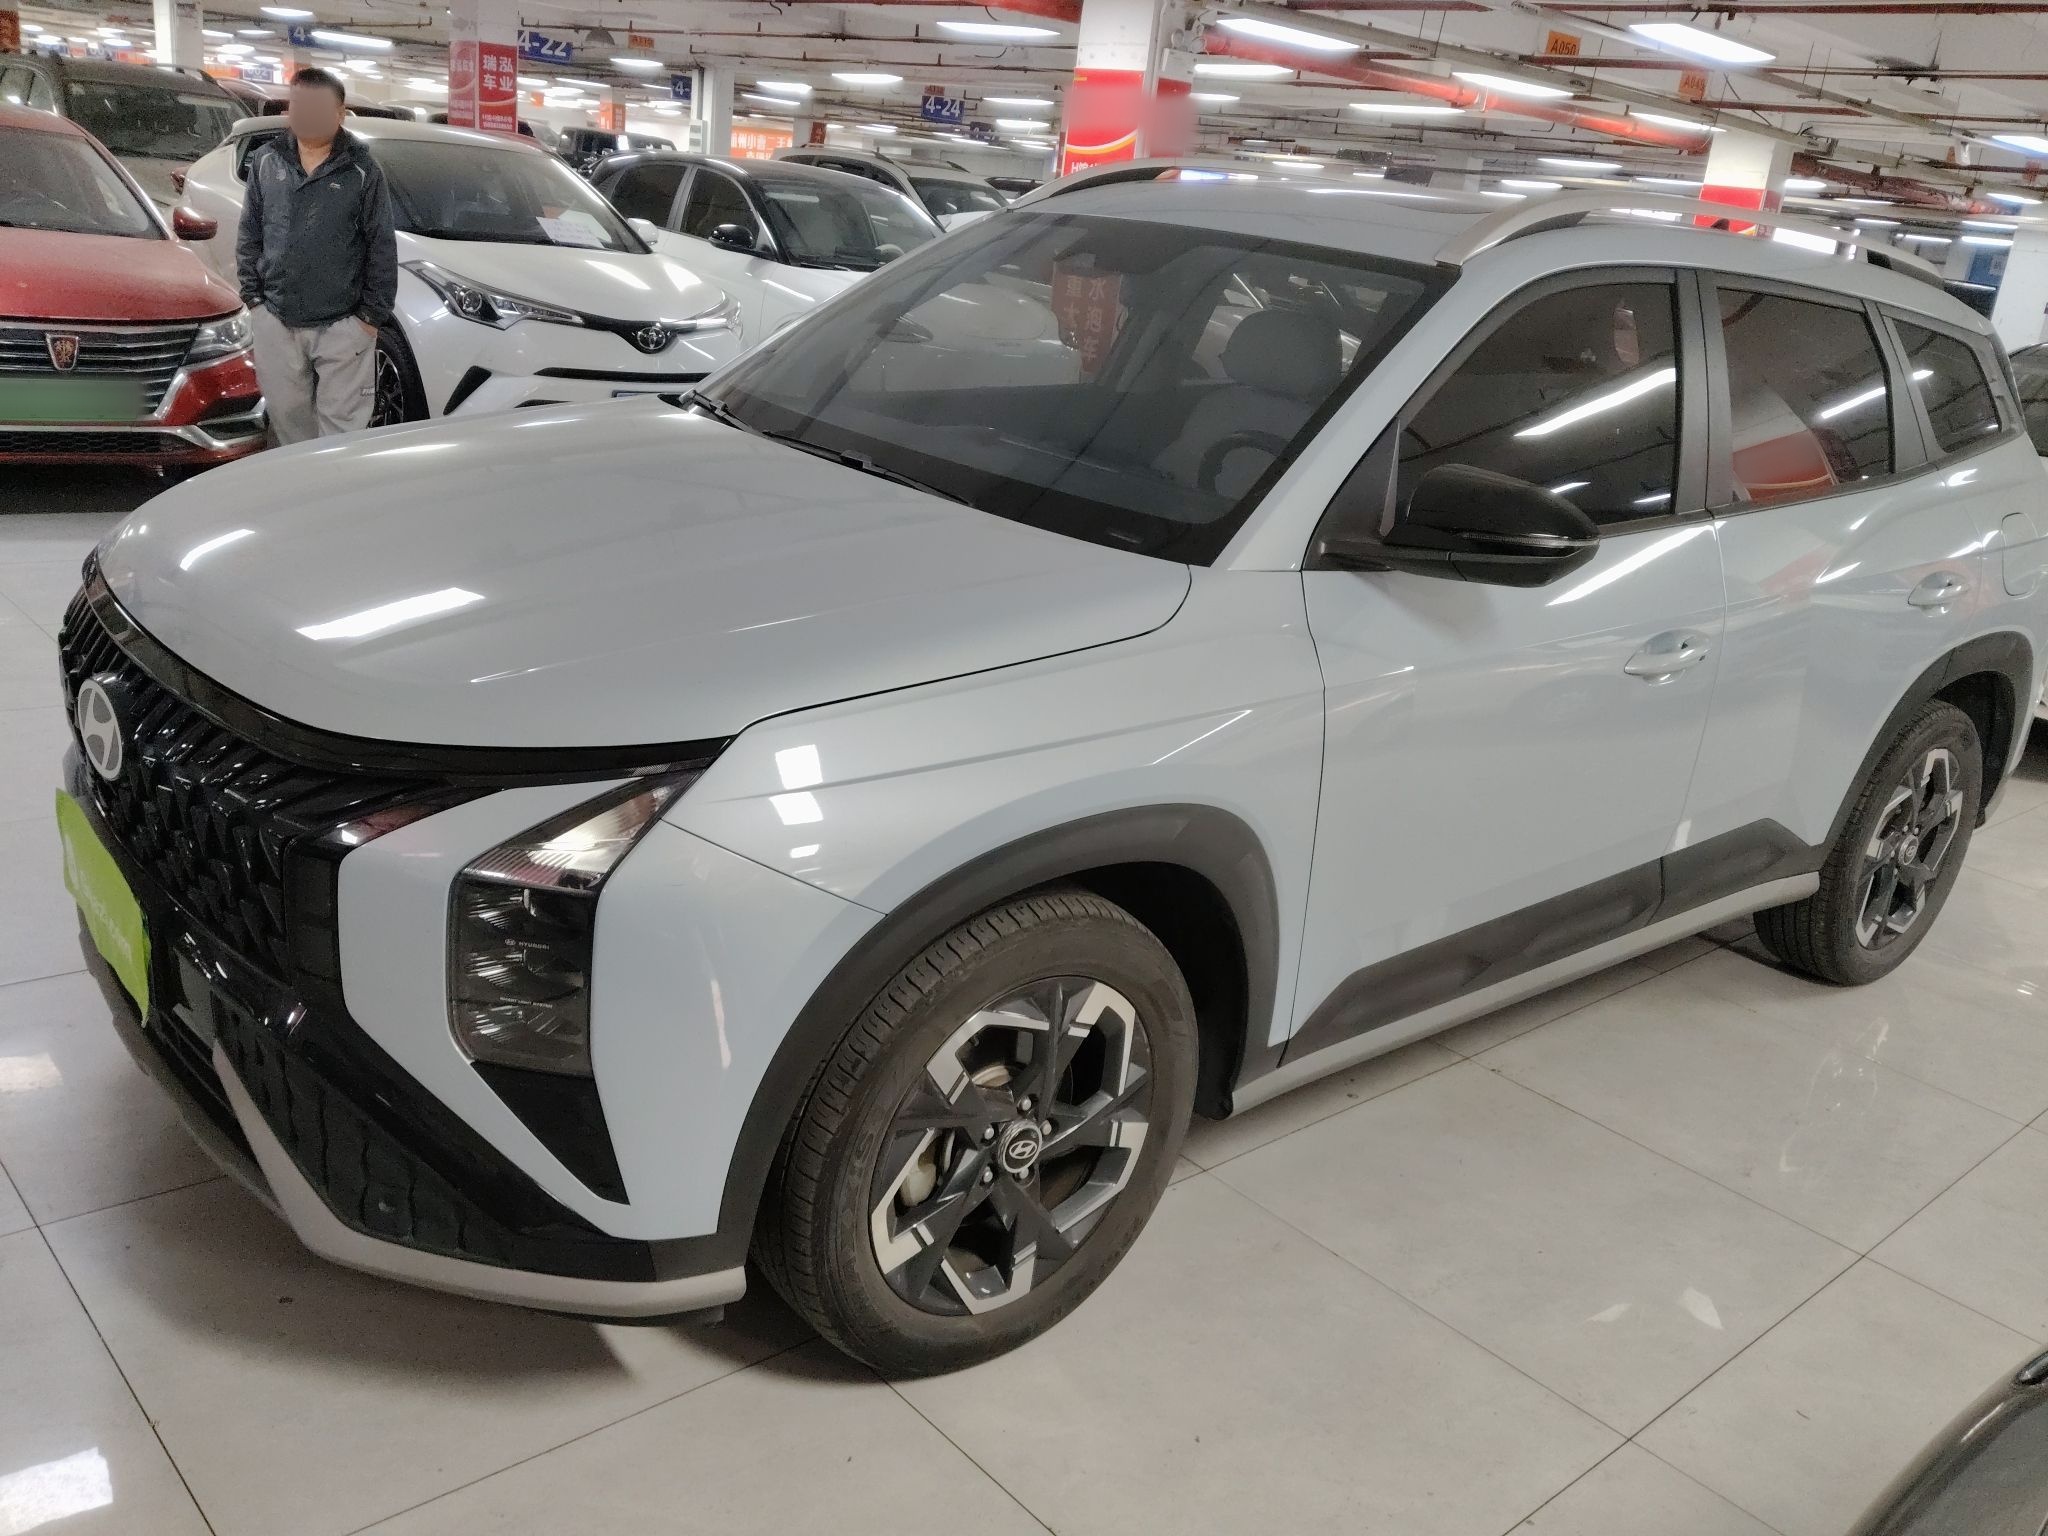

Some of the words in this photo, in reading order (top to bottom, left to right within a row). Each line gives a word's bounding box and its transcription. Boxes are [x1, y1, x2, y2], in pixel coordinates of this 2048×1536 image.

[518, 29, 567, 57] 4-22
[482, 73, 514, 92] 车业
[925, 96, 961, 117] 4-24
